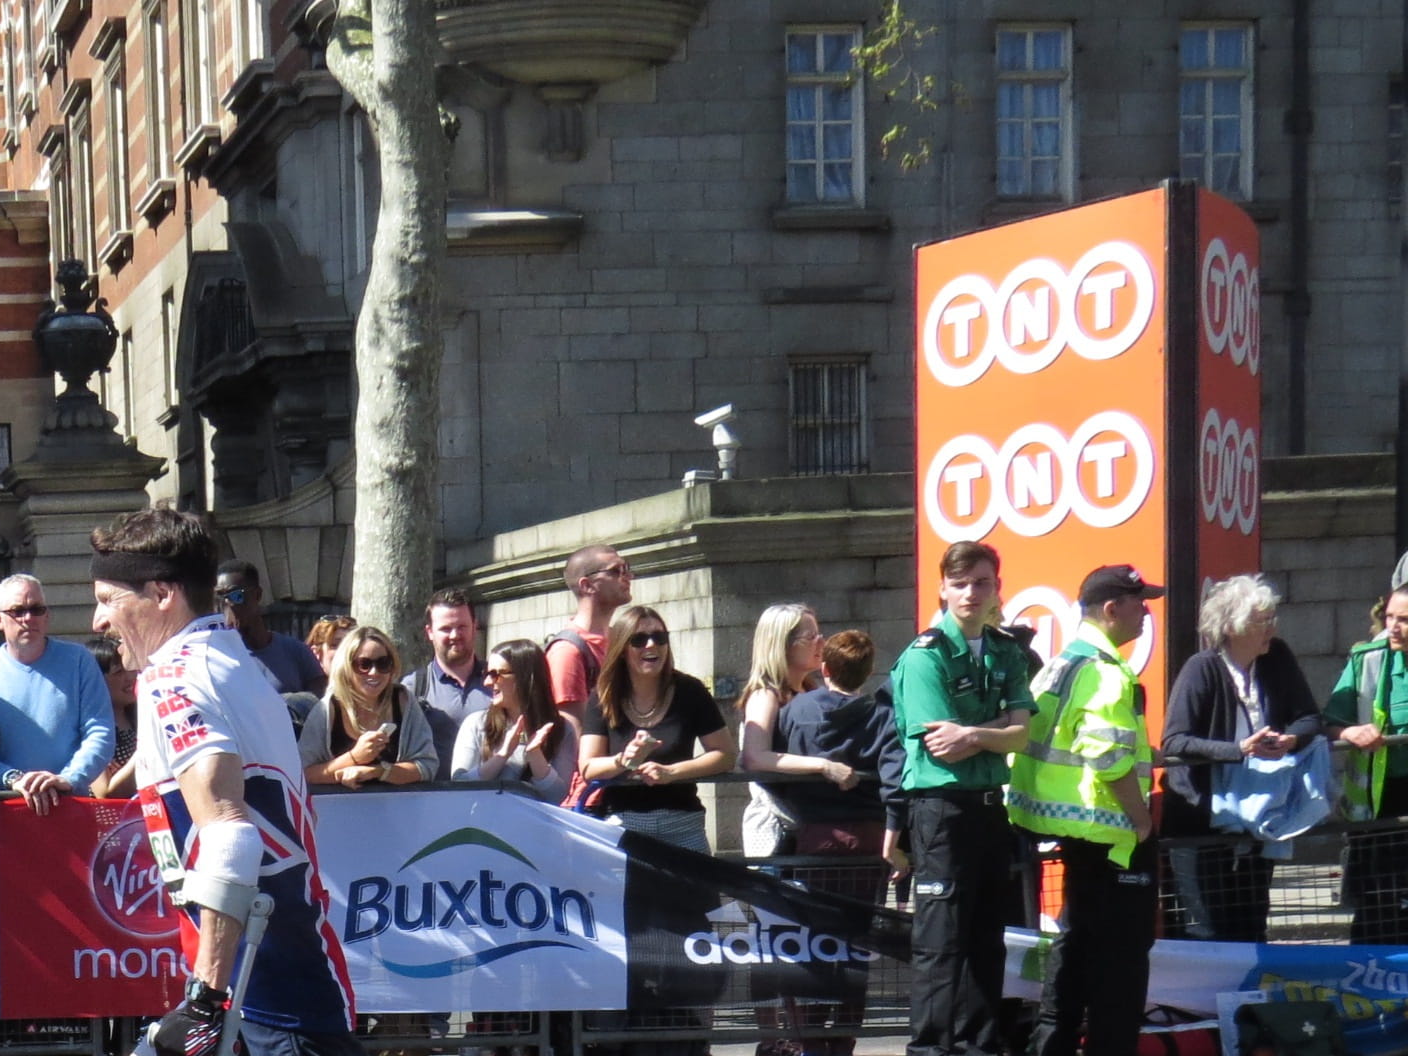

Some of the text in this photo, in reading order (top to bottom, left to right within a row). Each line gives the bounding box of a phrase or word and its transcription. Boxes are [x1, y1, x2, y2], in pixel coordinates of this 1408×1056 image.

[171, 726, 208, 753] BCF
[142, 802, 164, 818] ney
[344, 870, 599, 945] Buxton
[684, 922, 881, 964] adidas
